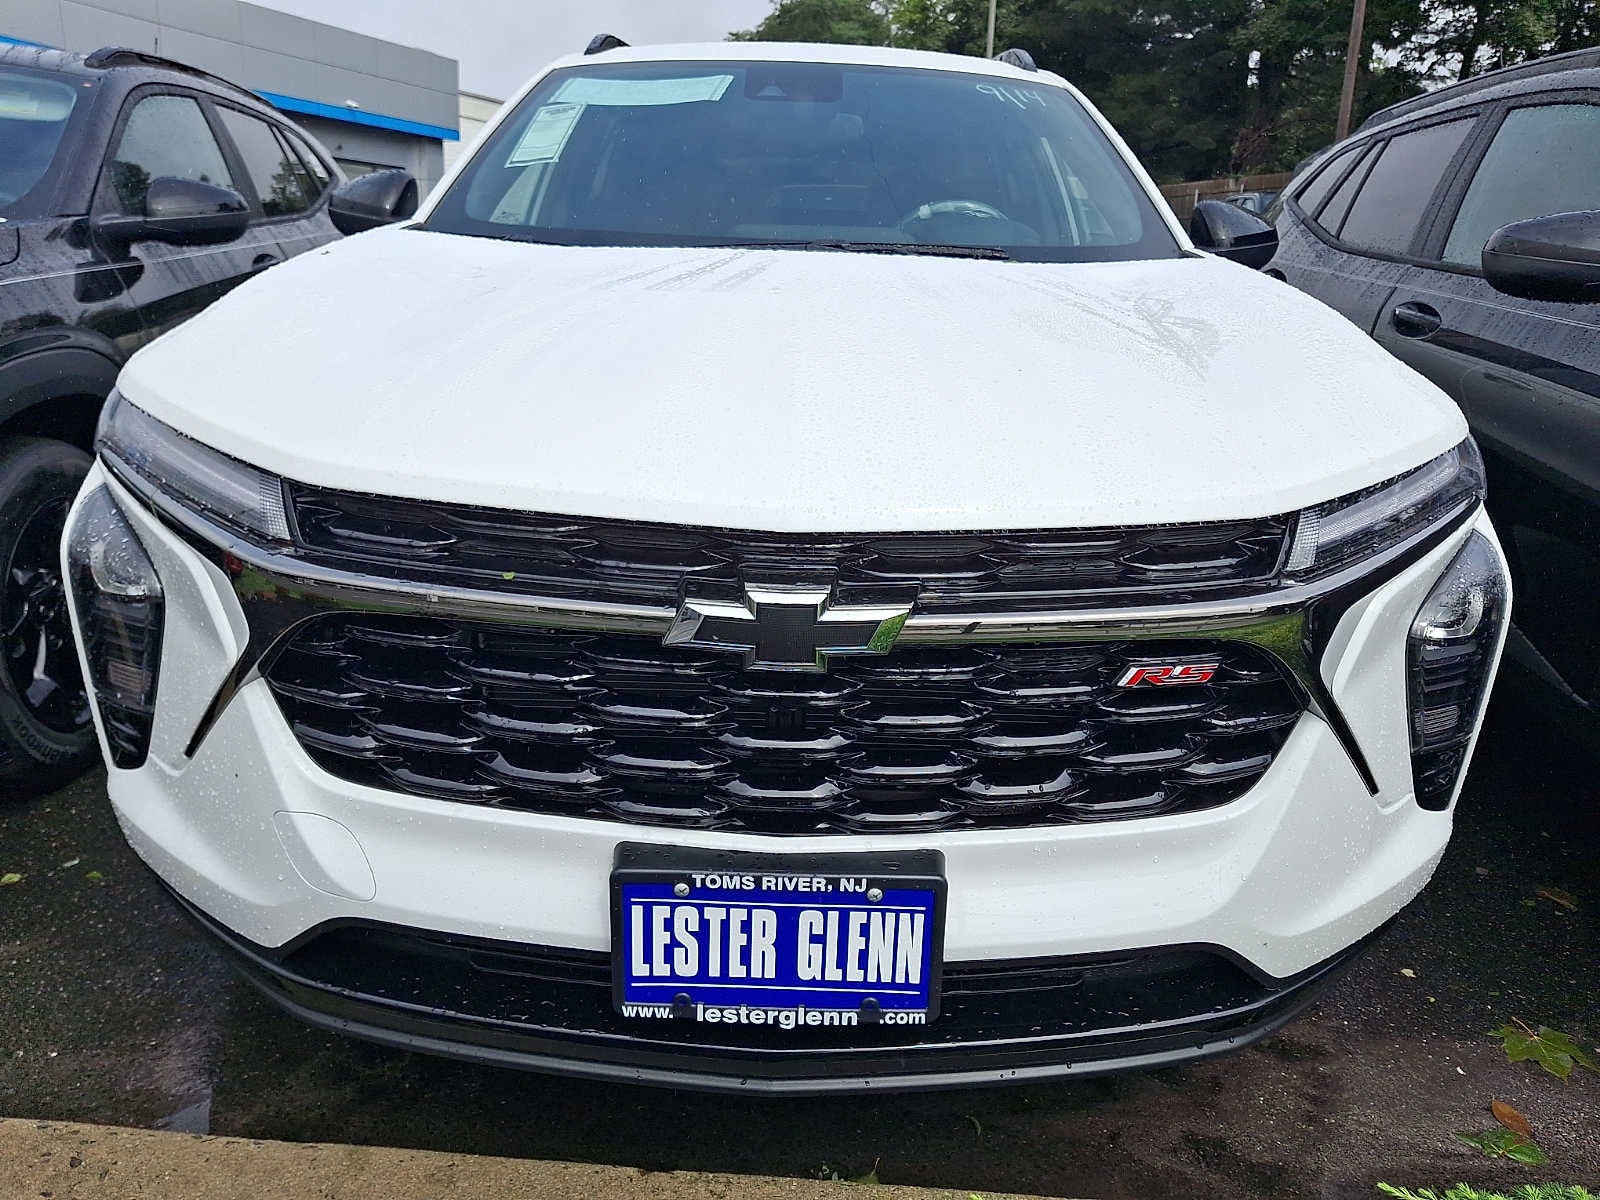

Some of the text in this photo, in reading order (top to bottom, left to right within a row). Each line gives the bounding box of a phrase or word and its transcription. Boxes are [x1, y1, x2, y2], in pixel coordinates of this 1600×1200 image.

[975, 84, 1046, 110] 9/14
[1116, 663, 1219, 687] RS
[691, 874, 868, 893] TOMS RIVER, NJ
[630, 904, 926, 985] LESTER GLENN
[696, 1001, 859, 1030] lesterglenn
